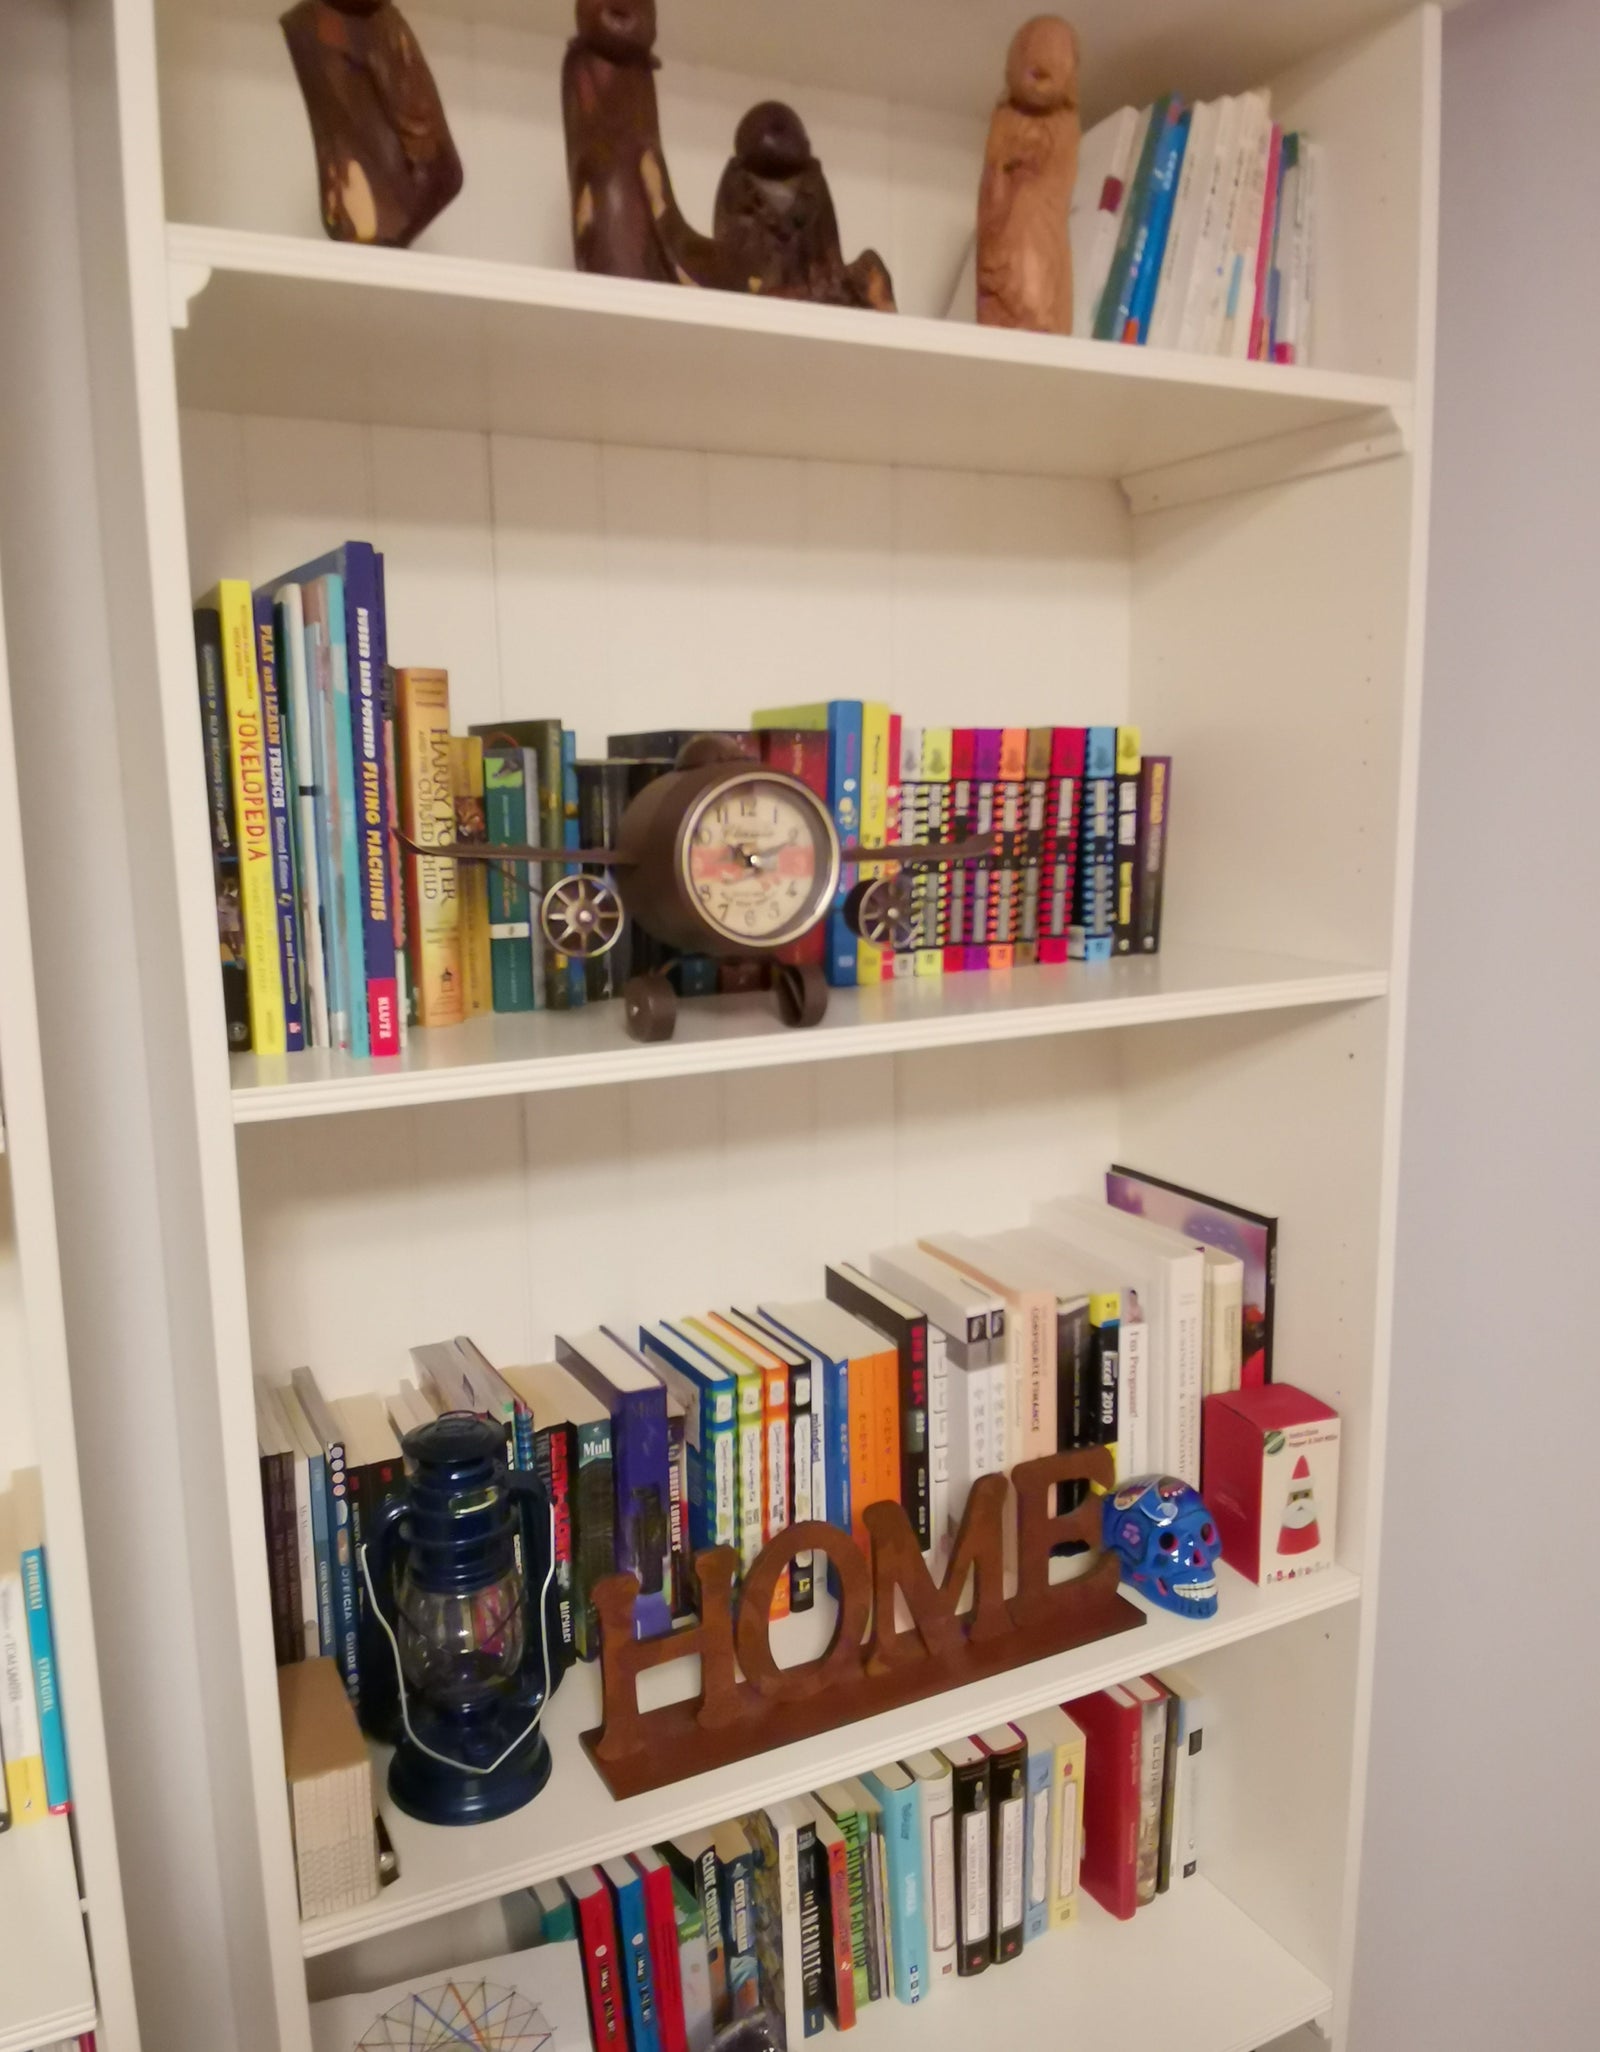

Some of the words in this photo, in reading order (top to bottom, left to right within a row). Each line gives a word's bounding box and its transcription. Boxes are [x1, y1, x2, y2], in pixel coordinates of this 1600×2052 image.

[260, 625, 275, 663] PLAY
[357, 607, 370, 657] RUBBER
[264, 666, 276, 692] and
[359, 661, 372, 697] BAND
[265, 696, 280, 744] LEARN
[361, 698, 375, 759] POWERED
[237, 709, 267, 861] JOKELOPEDIA
[268, 747, 284, 808] FRENCH
[363, 761, 381, 825] FLYING
[430, 729, 452, 815] HARRY
[418, 778, 435, 842] CURSED
[740, 800, 757, 817] 12
[367, 830, 387, 921] MACHINES
[434, 817, 456, 904] POTER
[378, 995, 391, 1040] KLUTZ
[1102, 1351, 1118, 1386] Excel
[1031, 1381, 1040, 1432] FINANCE
[1101, 1391, 1114, 1424] 2010
[583, 1438, 610, 1456] Mull
[812, 1413, 821, 1463] mindset
[24, 1555, 42, 1610] SPINELLI
[591, 1446, 1120, 1760] HOME
[345, 1632, 356, 1671] GUIDE
[37, 1657, 54, 1713] STARGIRL
[702, 1851, 716, 1890] CLIVE
[734, 1879, 746, 1911] CLIVE
[704, 1888, 720, 1945] CUSSLER
[802, 1906, 821, 1979] INFINITE
